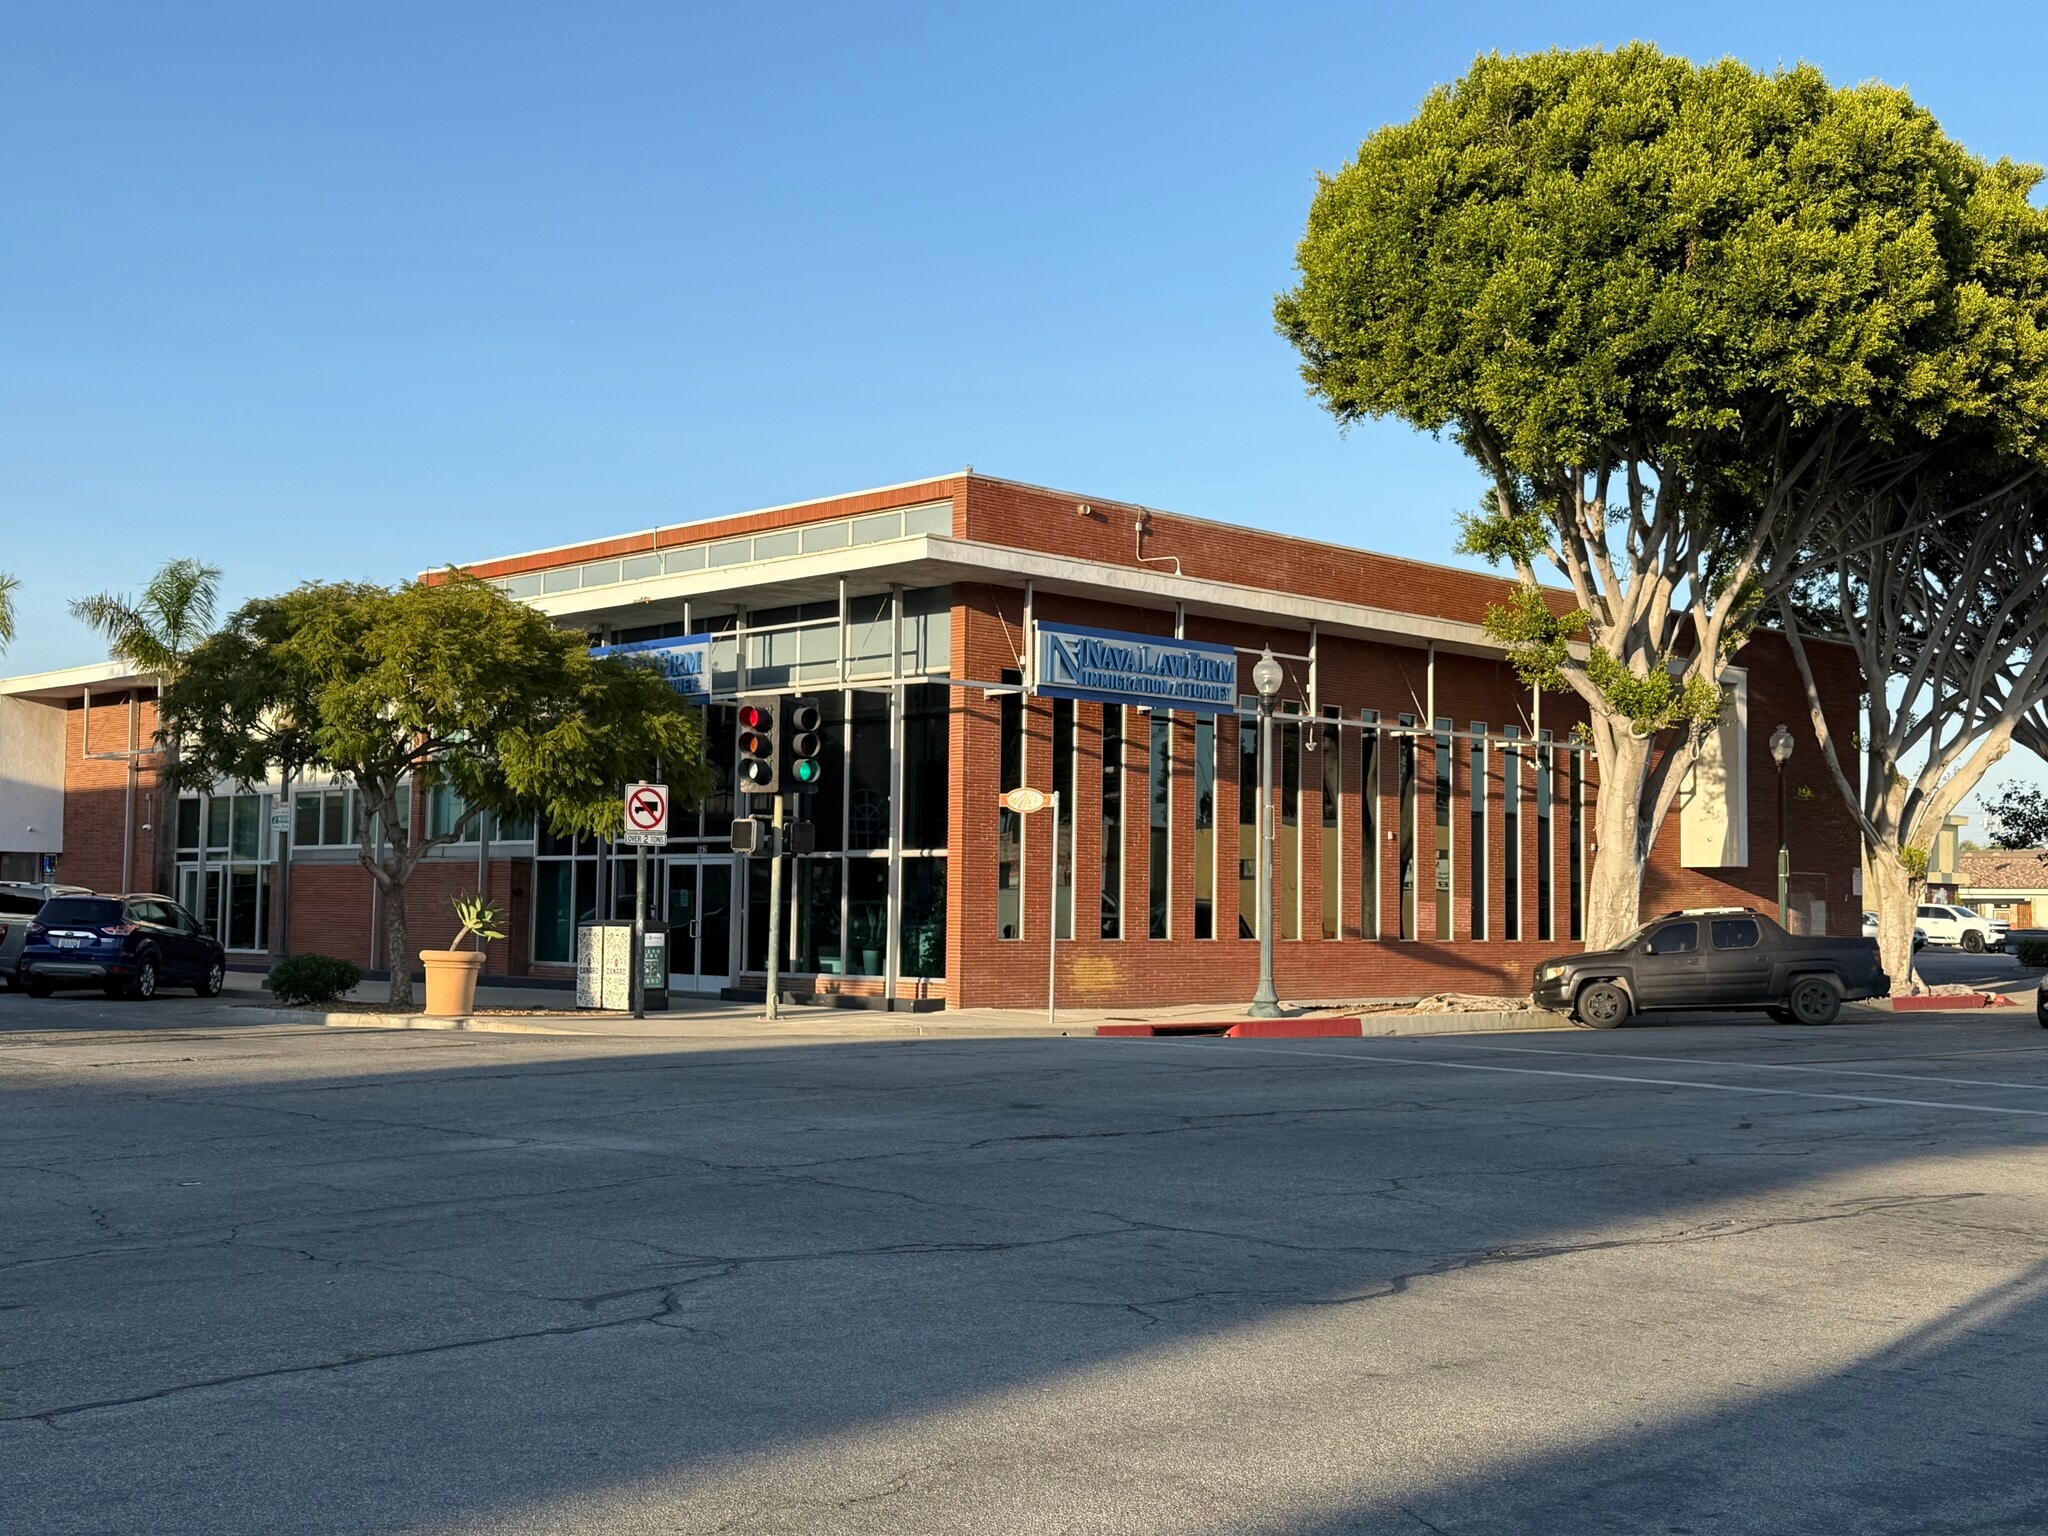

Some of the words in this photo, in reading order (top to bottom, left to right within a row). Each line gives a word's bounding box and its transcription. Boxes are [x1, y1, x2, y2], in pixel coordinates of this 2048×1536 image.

[1085, 639, 1136, 673] NAVA
[1139, 645, 1187, 678] LAW
[1185, 651, 1235, 684] FIRM
[1085, 671, 1168, 696] IMMIGRATION
[1171, 681, 1232, 701] ATTORNEY
[628, 835, 642, 843] OVER
[643, 835, 649, 845] 2
[650, 835, 664, 844] TONS
